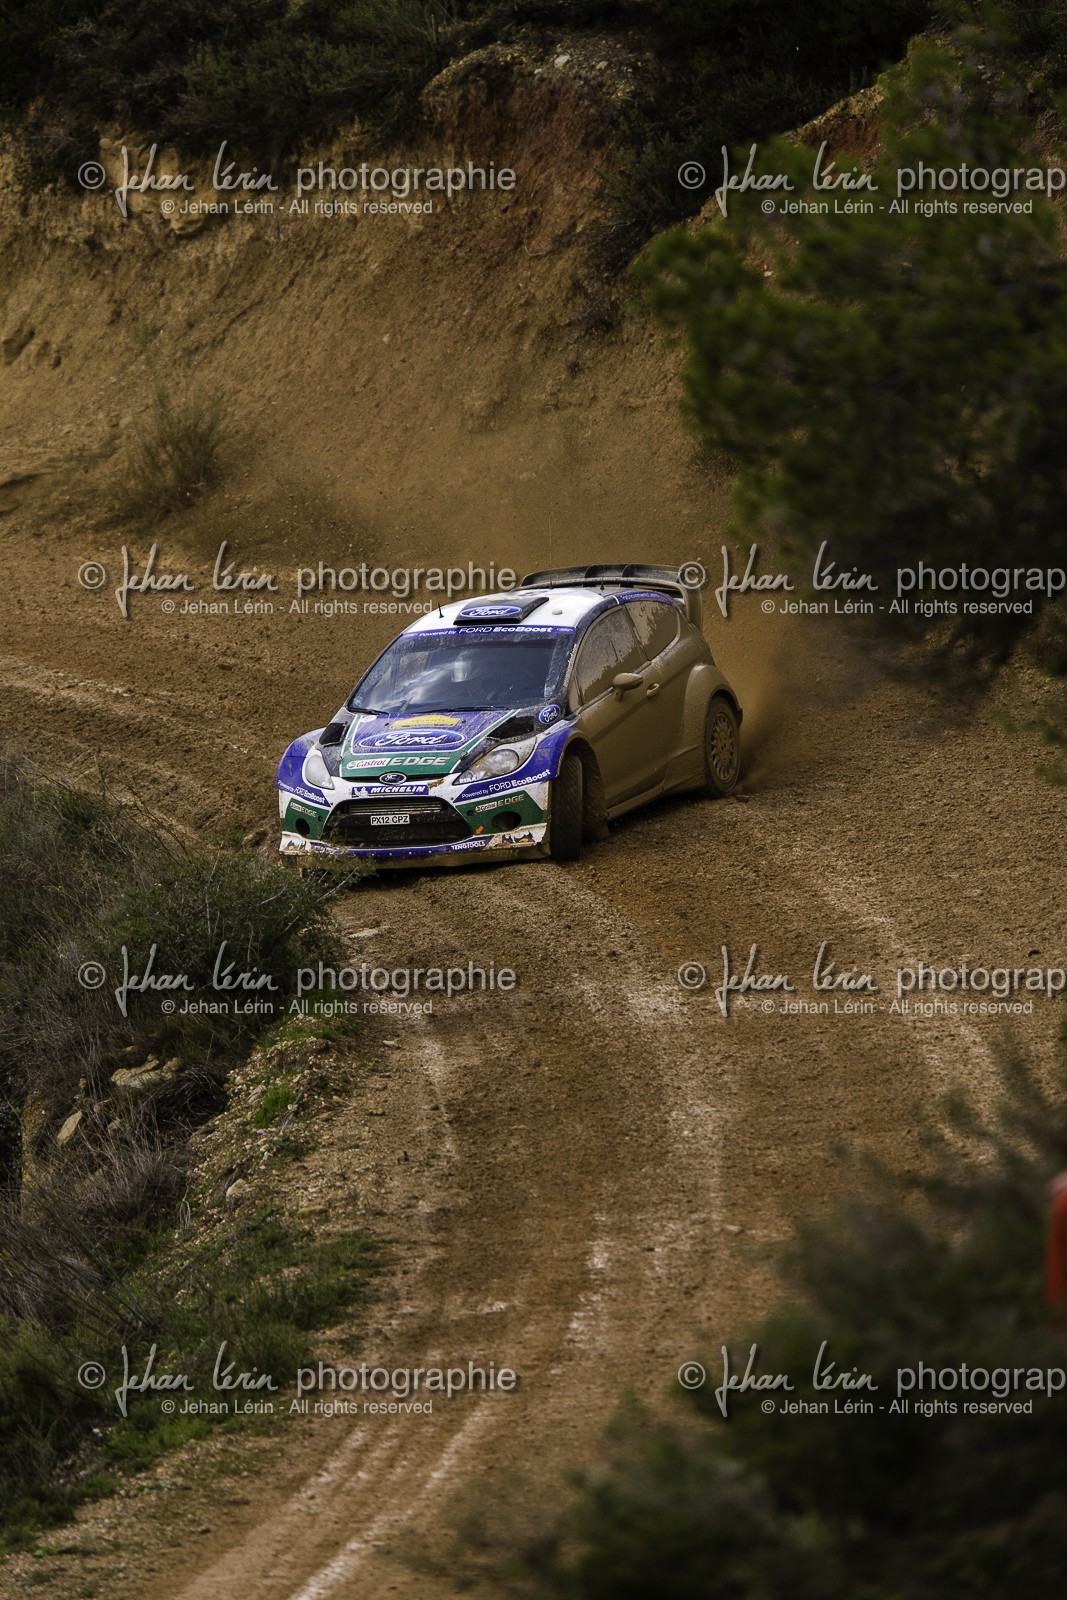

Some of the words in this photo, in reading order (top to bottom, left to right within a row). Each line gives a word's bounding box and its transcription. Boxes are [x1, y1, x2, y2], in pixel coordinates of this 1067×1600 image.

[468, 607, 511, 617] Ford
[459, 626, 492, 634] FORD
[375, 731, 447, 746] Ford
[356, 759, 387, 769] Castrol
[389, 756, 450, 766] EDGE
[370, 785, 426, 794] MICHELIN
[461, 790, 483, 799] Powered
[482, 788, 489, 796] by
[489, 781, 512, 793] FORD
[511, 769, 551, 787] EcoBoost
[497, 794, 524, 807] EDGE
[371, 816, 390, 825] PX12
